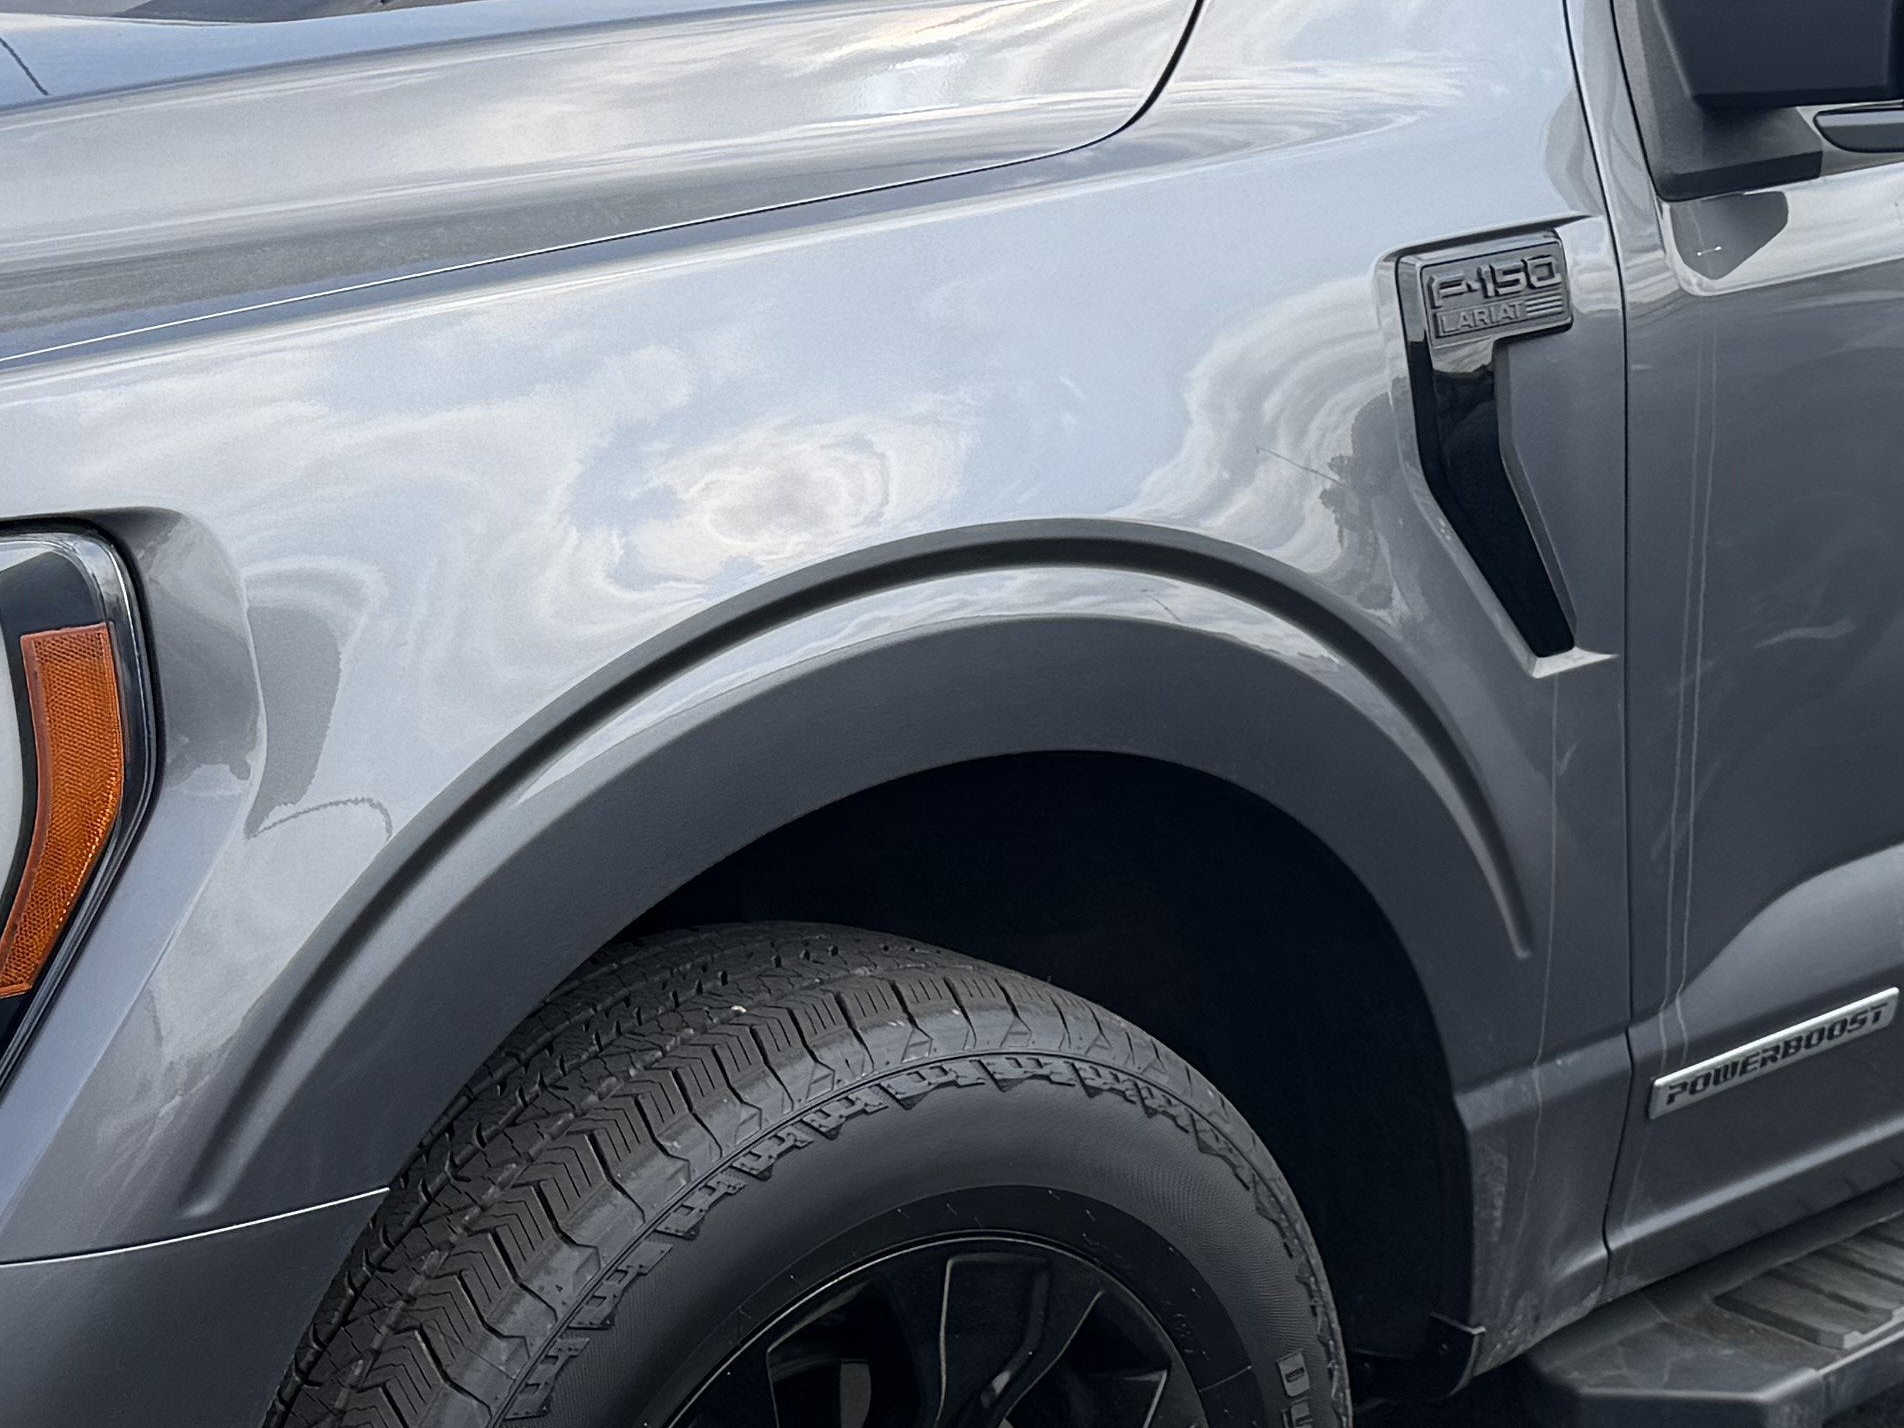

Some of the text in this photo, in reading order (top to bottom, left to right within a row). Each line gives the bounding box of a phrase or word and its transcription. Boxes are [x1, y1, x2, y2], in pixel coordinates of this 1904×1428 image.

[1428, 254, 1563, 310] F-150
[1440, 301, 1526, 336] LARIAT
[1665, 1000, 1890, 1107] POWERBOOST
